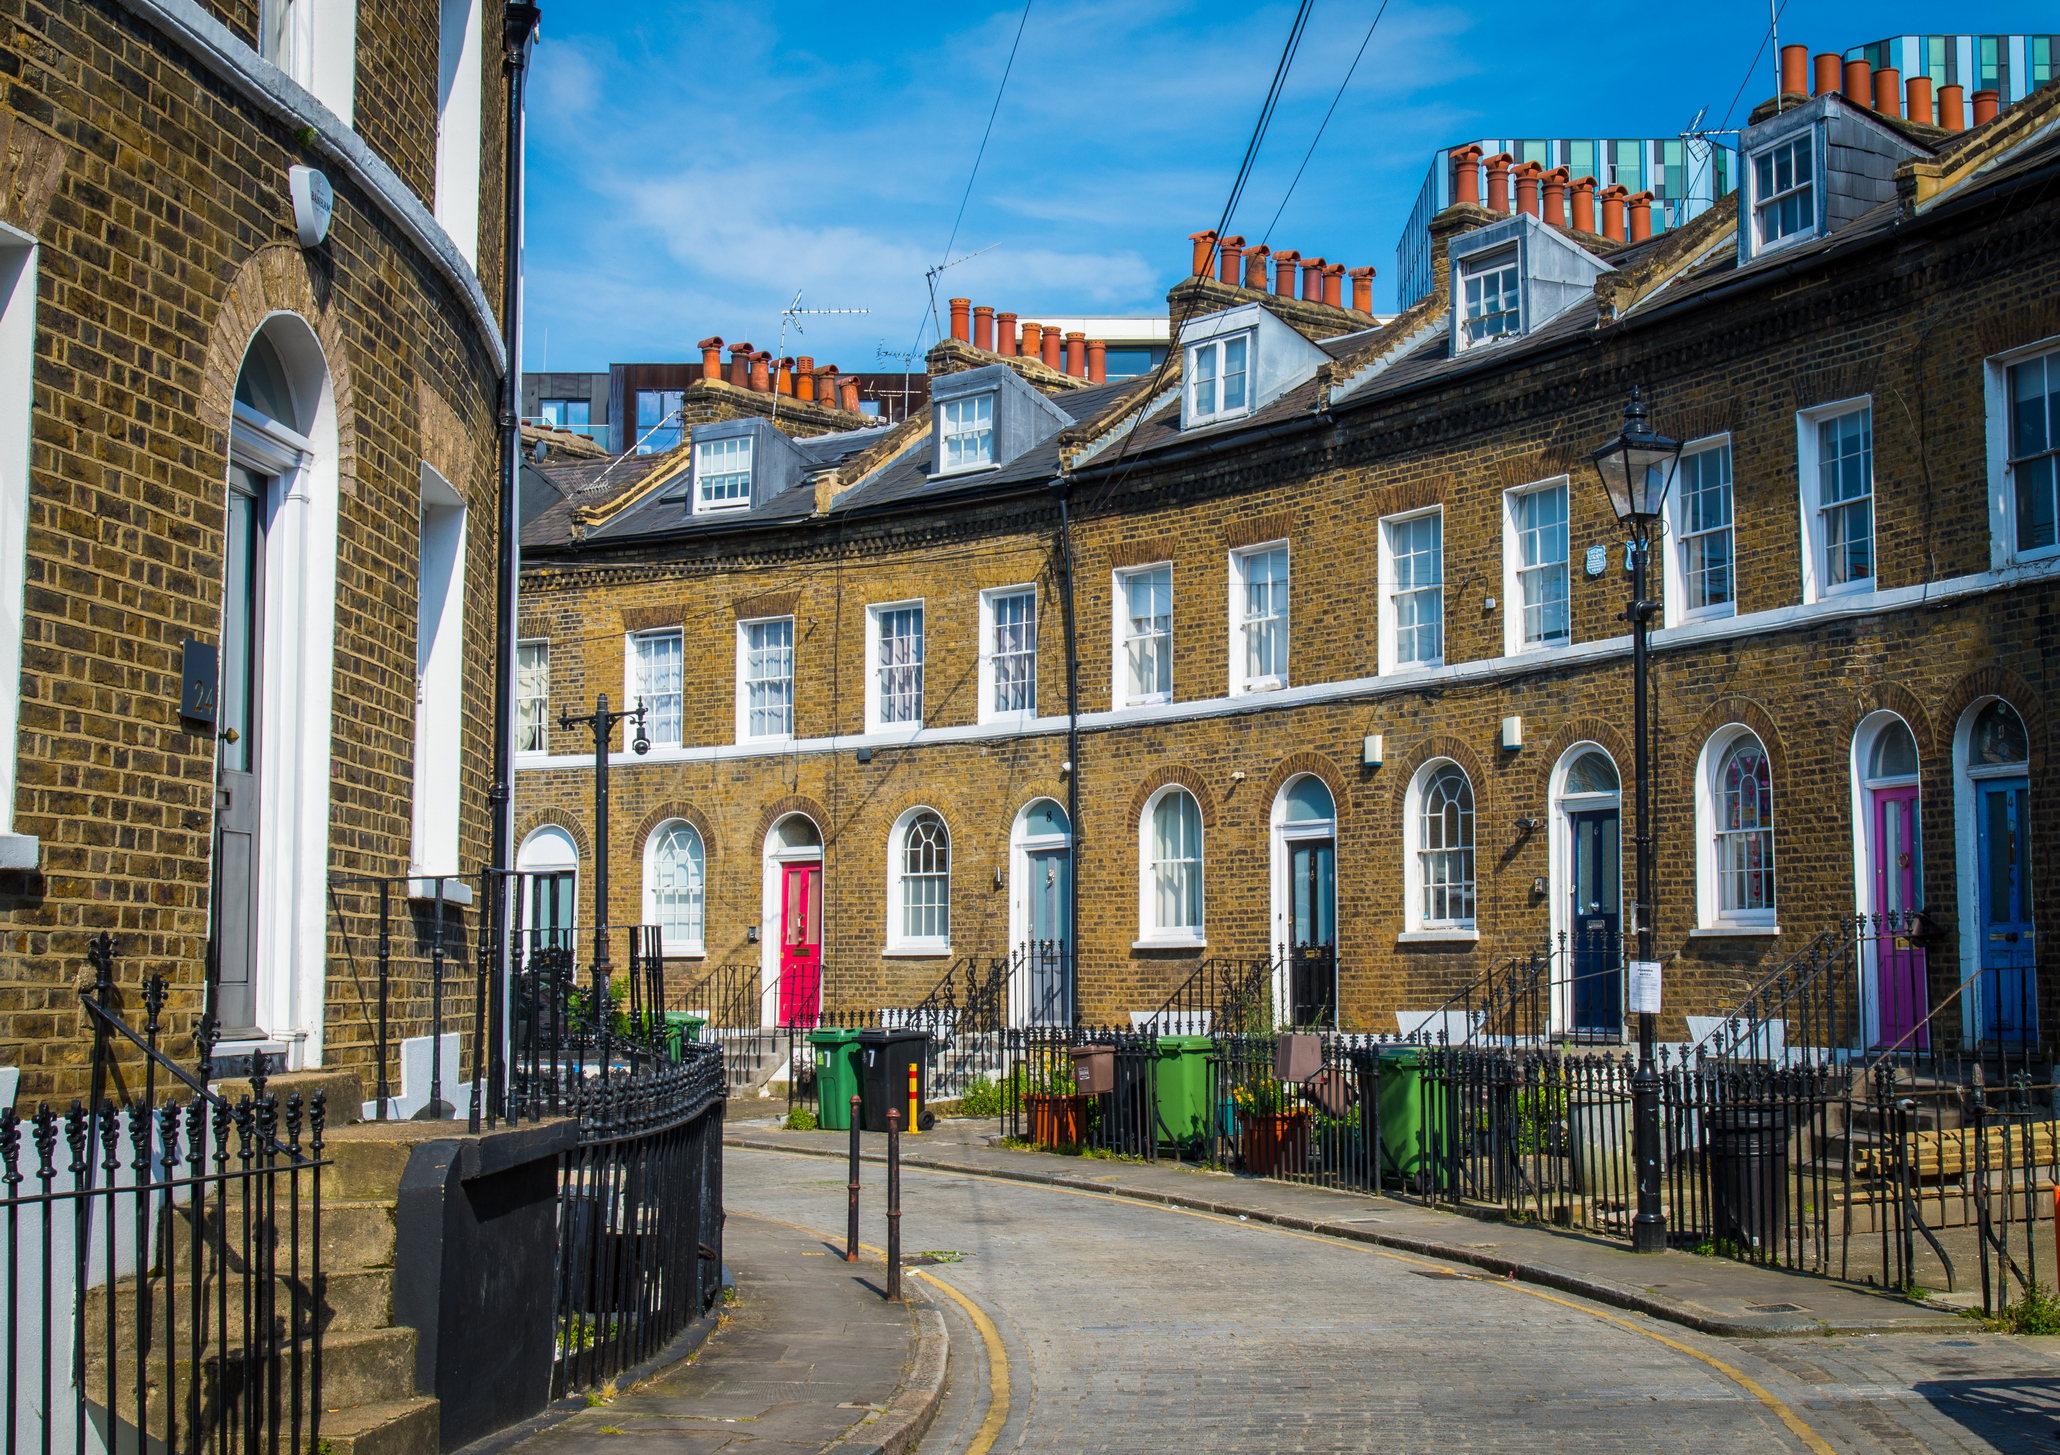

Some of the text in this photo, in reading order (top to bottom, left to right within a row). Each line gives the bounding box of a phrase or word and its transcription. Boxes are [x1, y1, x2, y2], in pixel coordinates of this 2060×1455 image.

[193, 679, 214, 715] 24
[1901, 800, 1907, 811] 5
[2008, 796, 2014, 808] 4
[1046, 810, 1052, 823] 8
[1593, 826, 1599, 836] 6
[1310, 856, 1315, 866] 7
